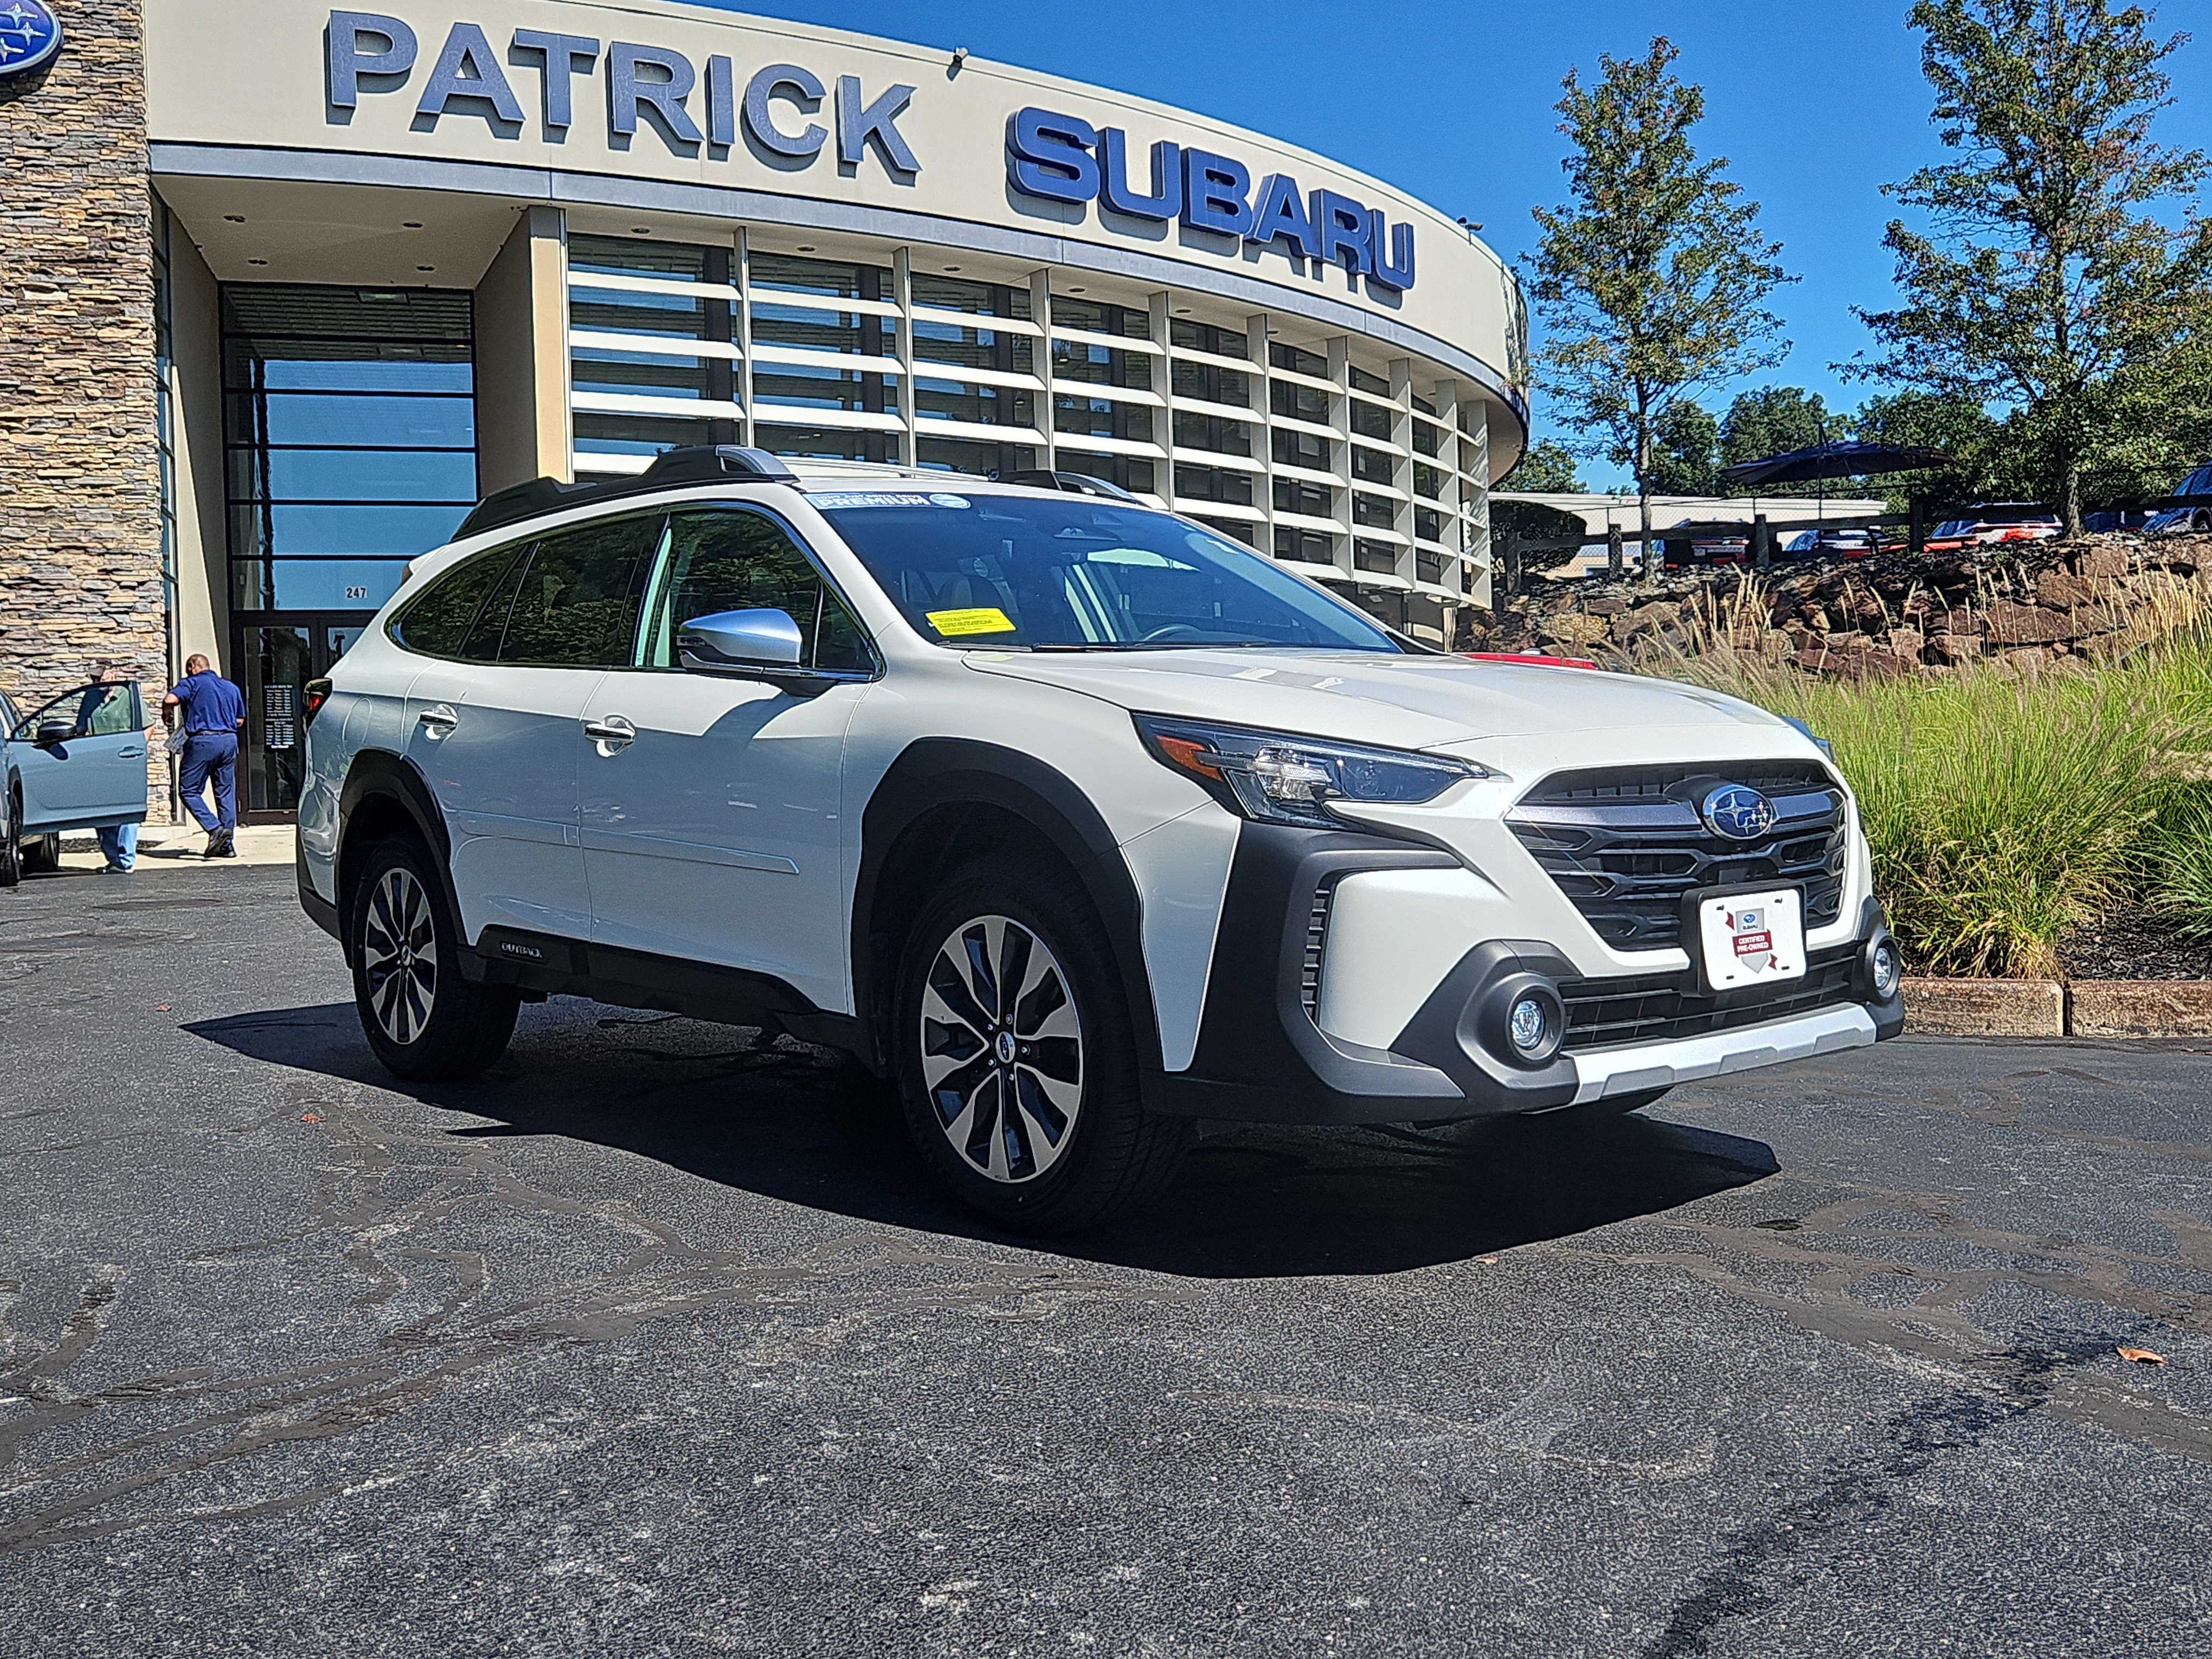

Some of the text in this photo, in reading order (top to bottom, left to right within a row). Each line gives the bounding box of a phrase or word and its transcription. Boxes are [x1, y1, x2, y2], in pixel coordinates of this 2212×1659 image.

[327, 10, 1415, 291] PATRICK SUBARU
[818, 497, 930, 506] PREMIUM
[346, 587, 366, 599] 247
[1738, 935, 1765, 944] CERTIFIED
[501, 943, 543, 958] OUTBACK
[1737, 942, 1769, 952] PRE-OWNED
